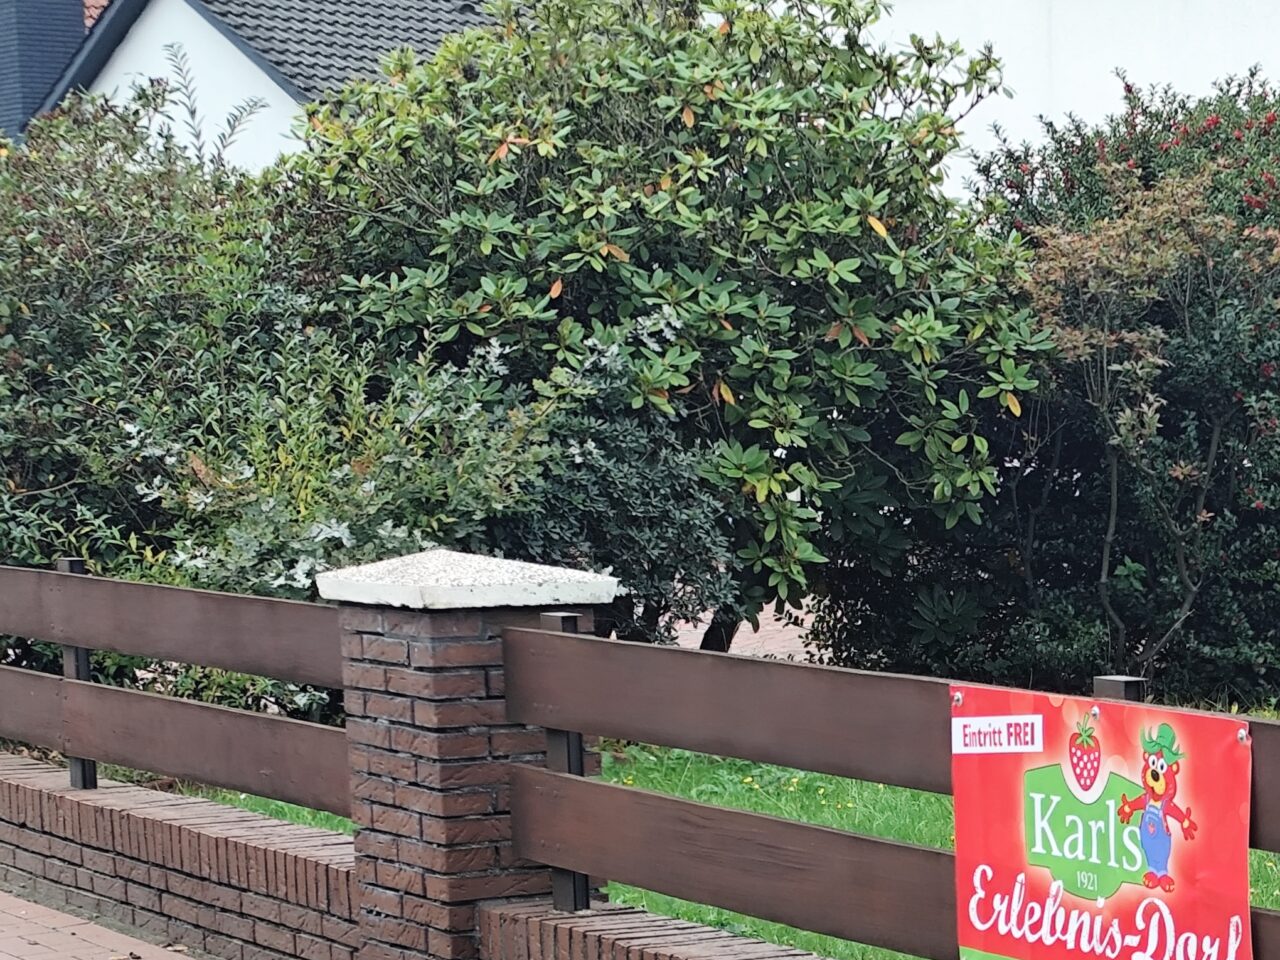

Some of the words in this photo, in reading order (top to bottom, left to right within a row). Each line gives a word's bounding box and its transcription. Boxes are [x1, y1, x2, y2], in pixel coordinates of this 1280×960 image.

[963, 722, 1002, 747] Eintritt
[1006, 722, 1035, 747] FREI
[1029, 791, 1143, 872] Karls
[1076, 870, 1098, 892] 1921
